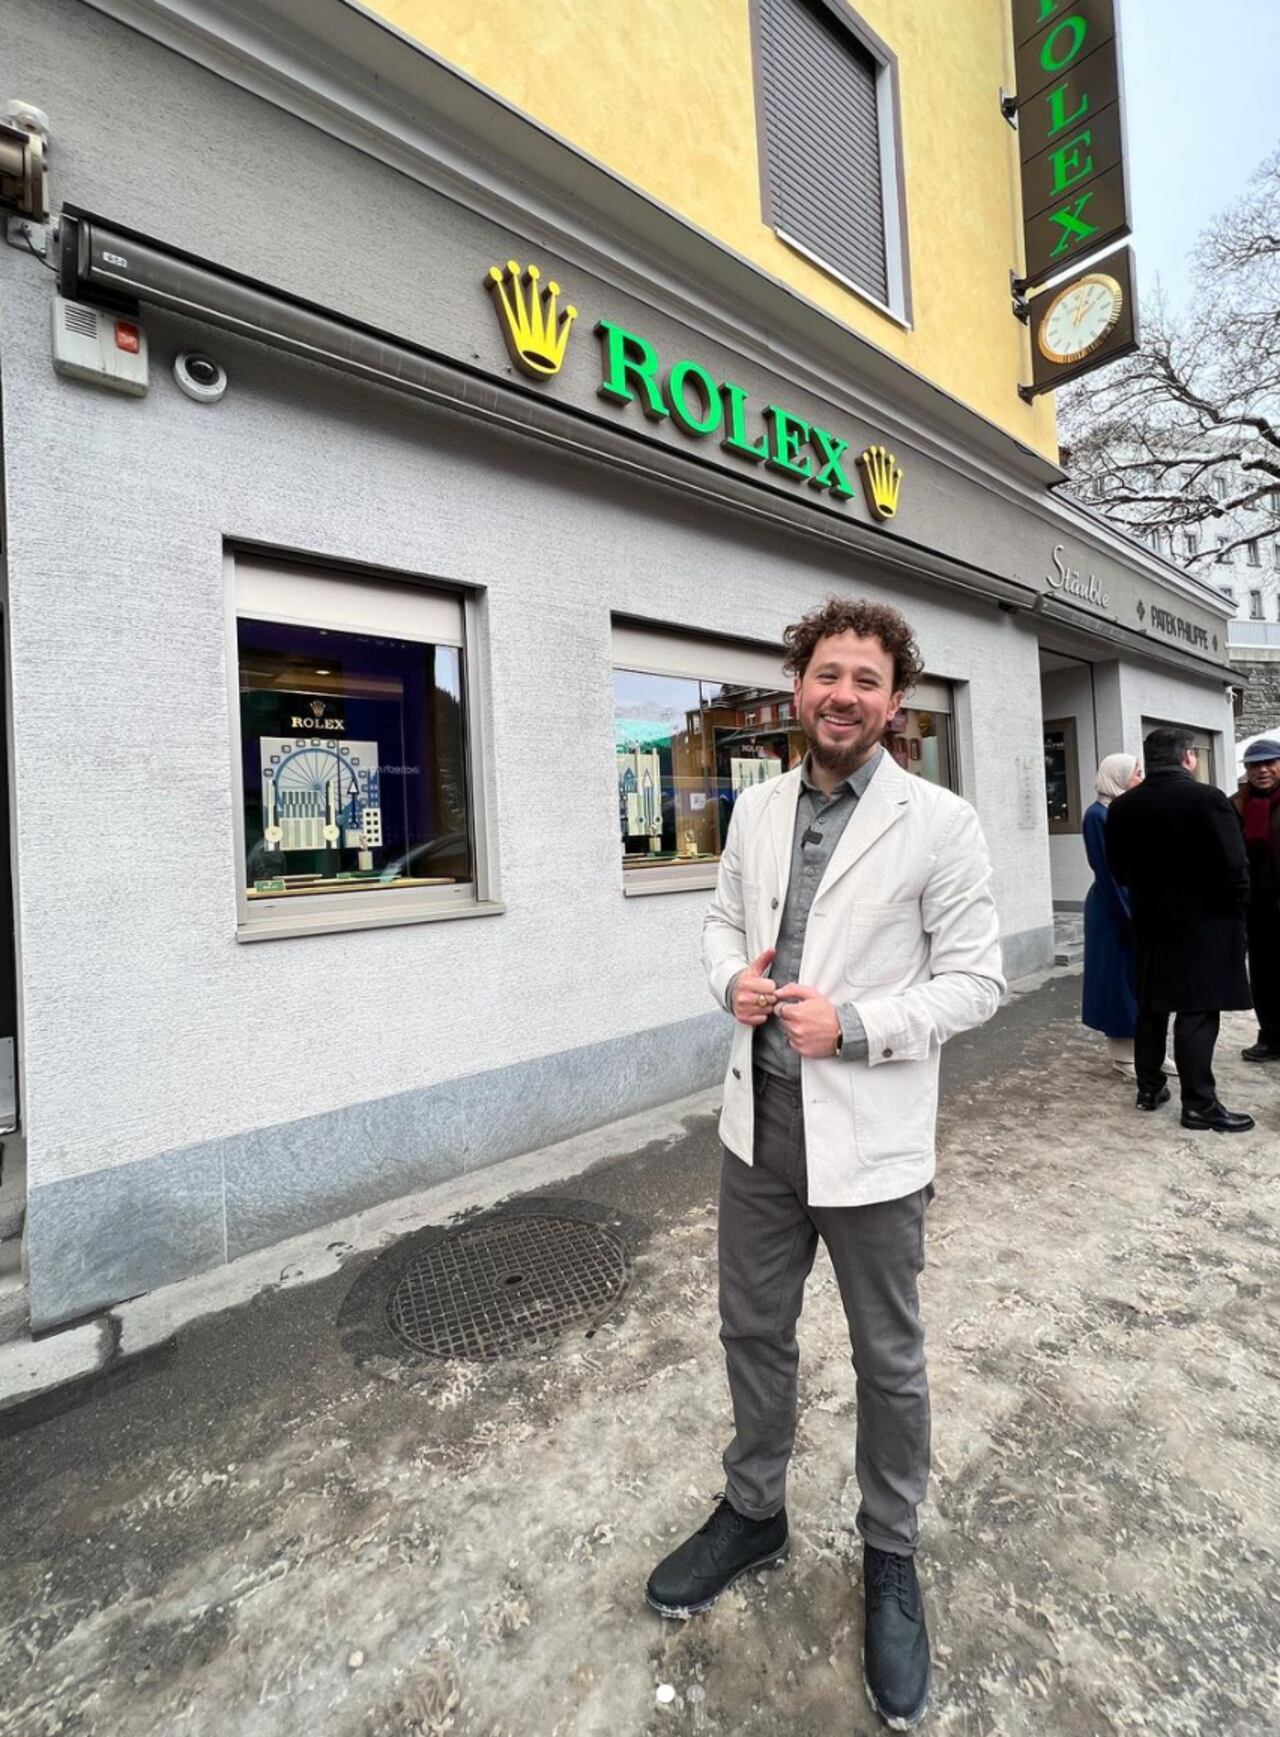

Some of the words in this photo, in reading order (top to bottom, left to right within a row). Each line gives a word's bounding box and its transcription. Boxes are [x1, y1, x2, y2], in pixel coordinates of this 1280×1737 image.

[1036, 0, 1099, 256] OLEX
[594, 319, 855, 500] ROLEX
[1046, 544, 1110, 609] Stäuble
[1151, 605, 1177, 637] PATEK
[1177, 617, 1208, 650] PHILIPPE
[291, 716, 345, 730] ROLEX
